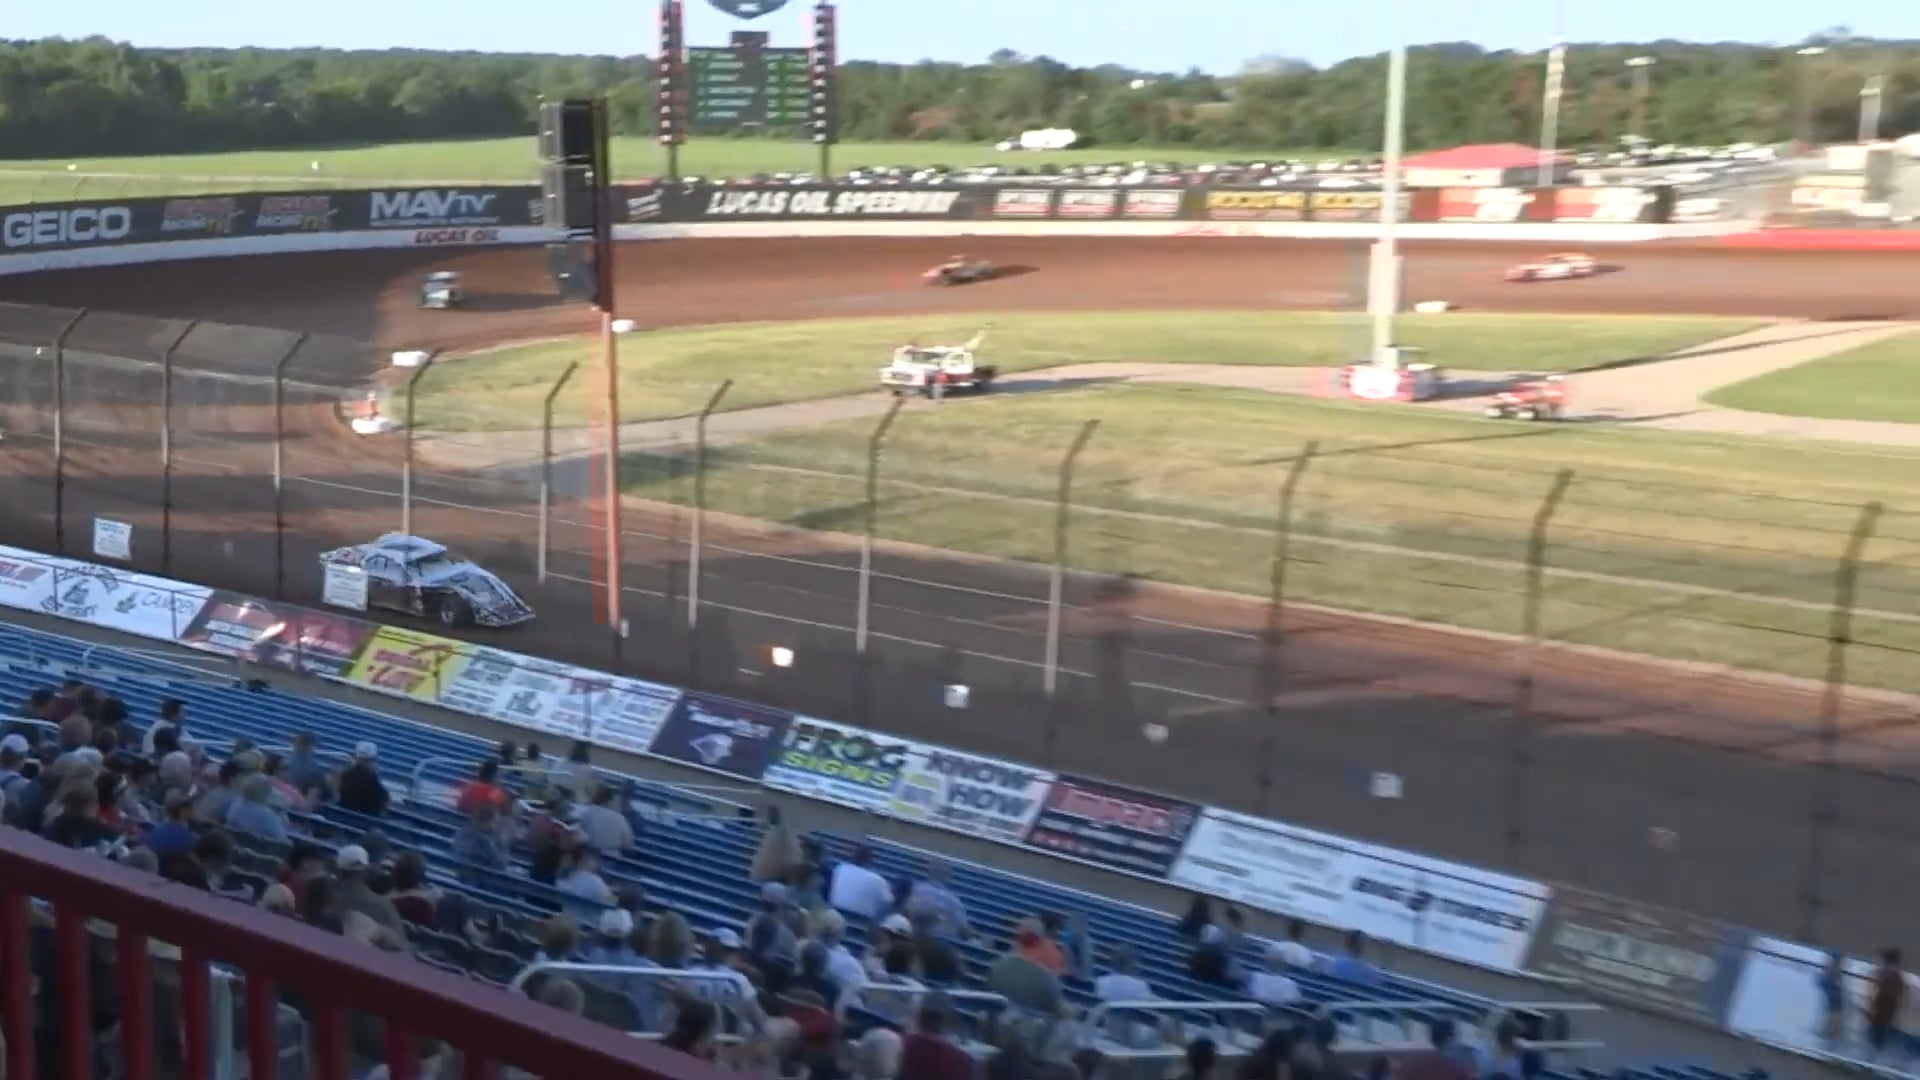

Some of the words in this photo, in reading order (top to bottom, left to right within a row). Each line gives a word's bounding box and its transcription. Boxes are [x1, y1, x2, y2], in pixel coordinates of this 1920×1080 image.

[369, 190, 496, 219] MAVTV
[706, 191, 788, 214] LUCAS
[789, 191, 831, 213] OIL
[832, 191, 960, 214] SPEEDWAY
[4, 206, 132, 247] GEICO
[413, 228, 467, 244] LUCAS
[785, 720, 909, 770] FROG
[783, 751, 897, 789] SIGNS
[923, 749, 1036, 792] KNOW
[948, 780, 1035, 818] HOW
